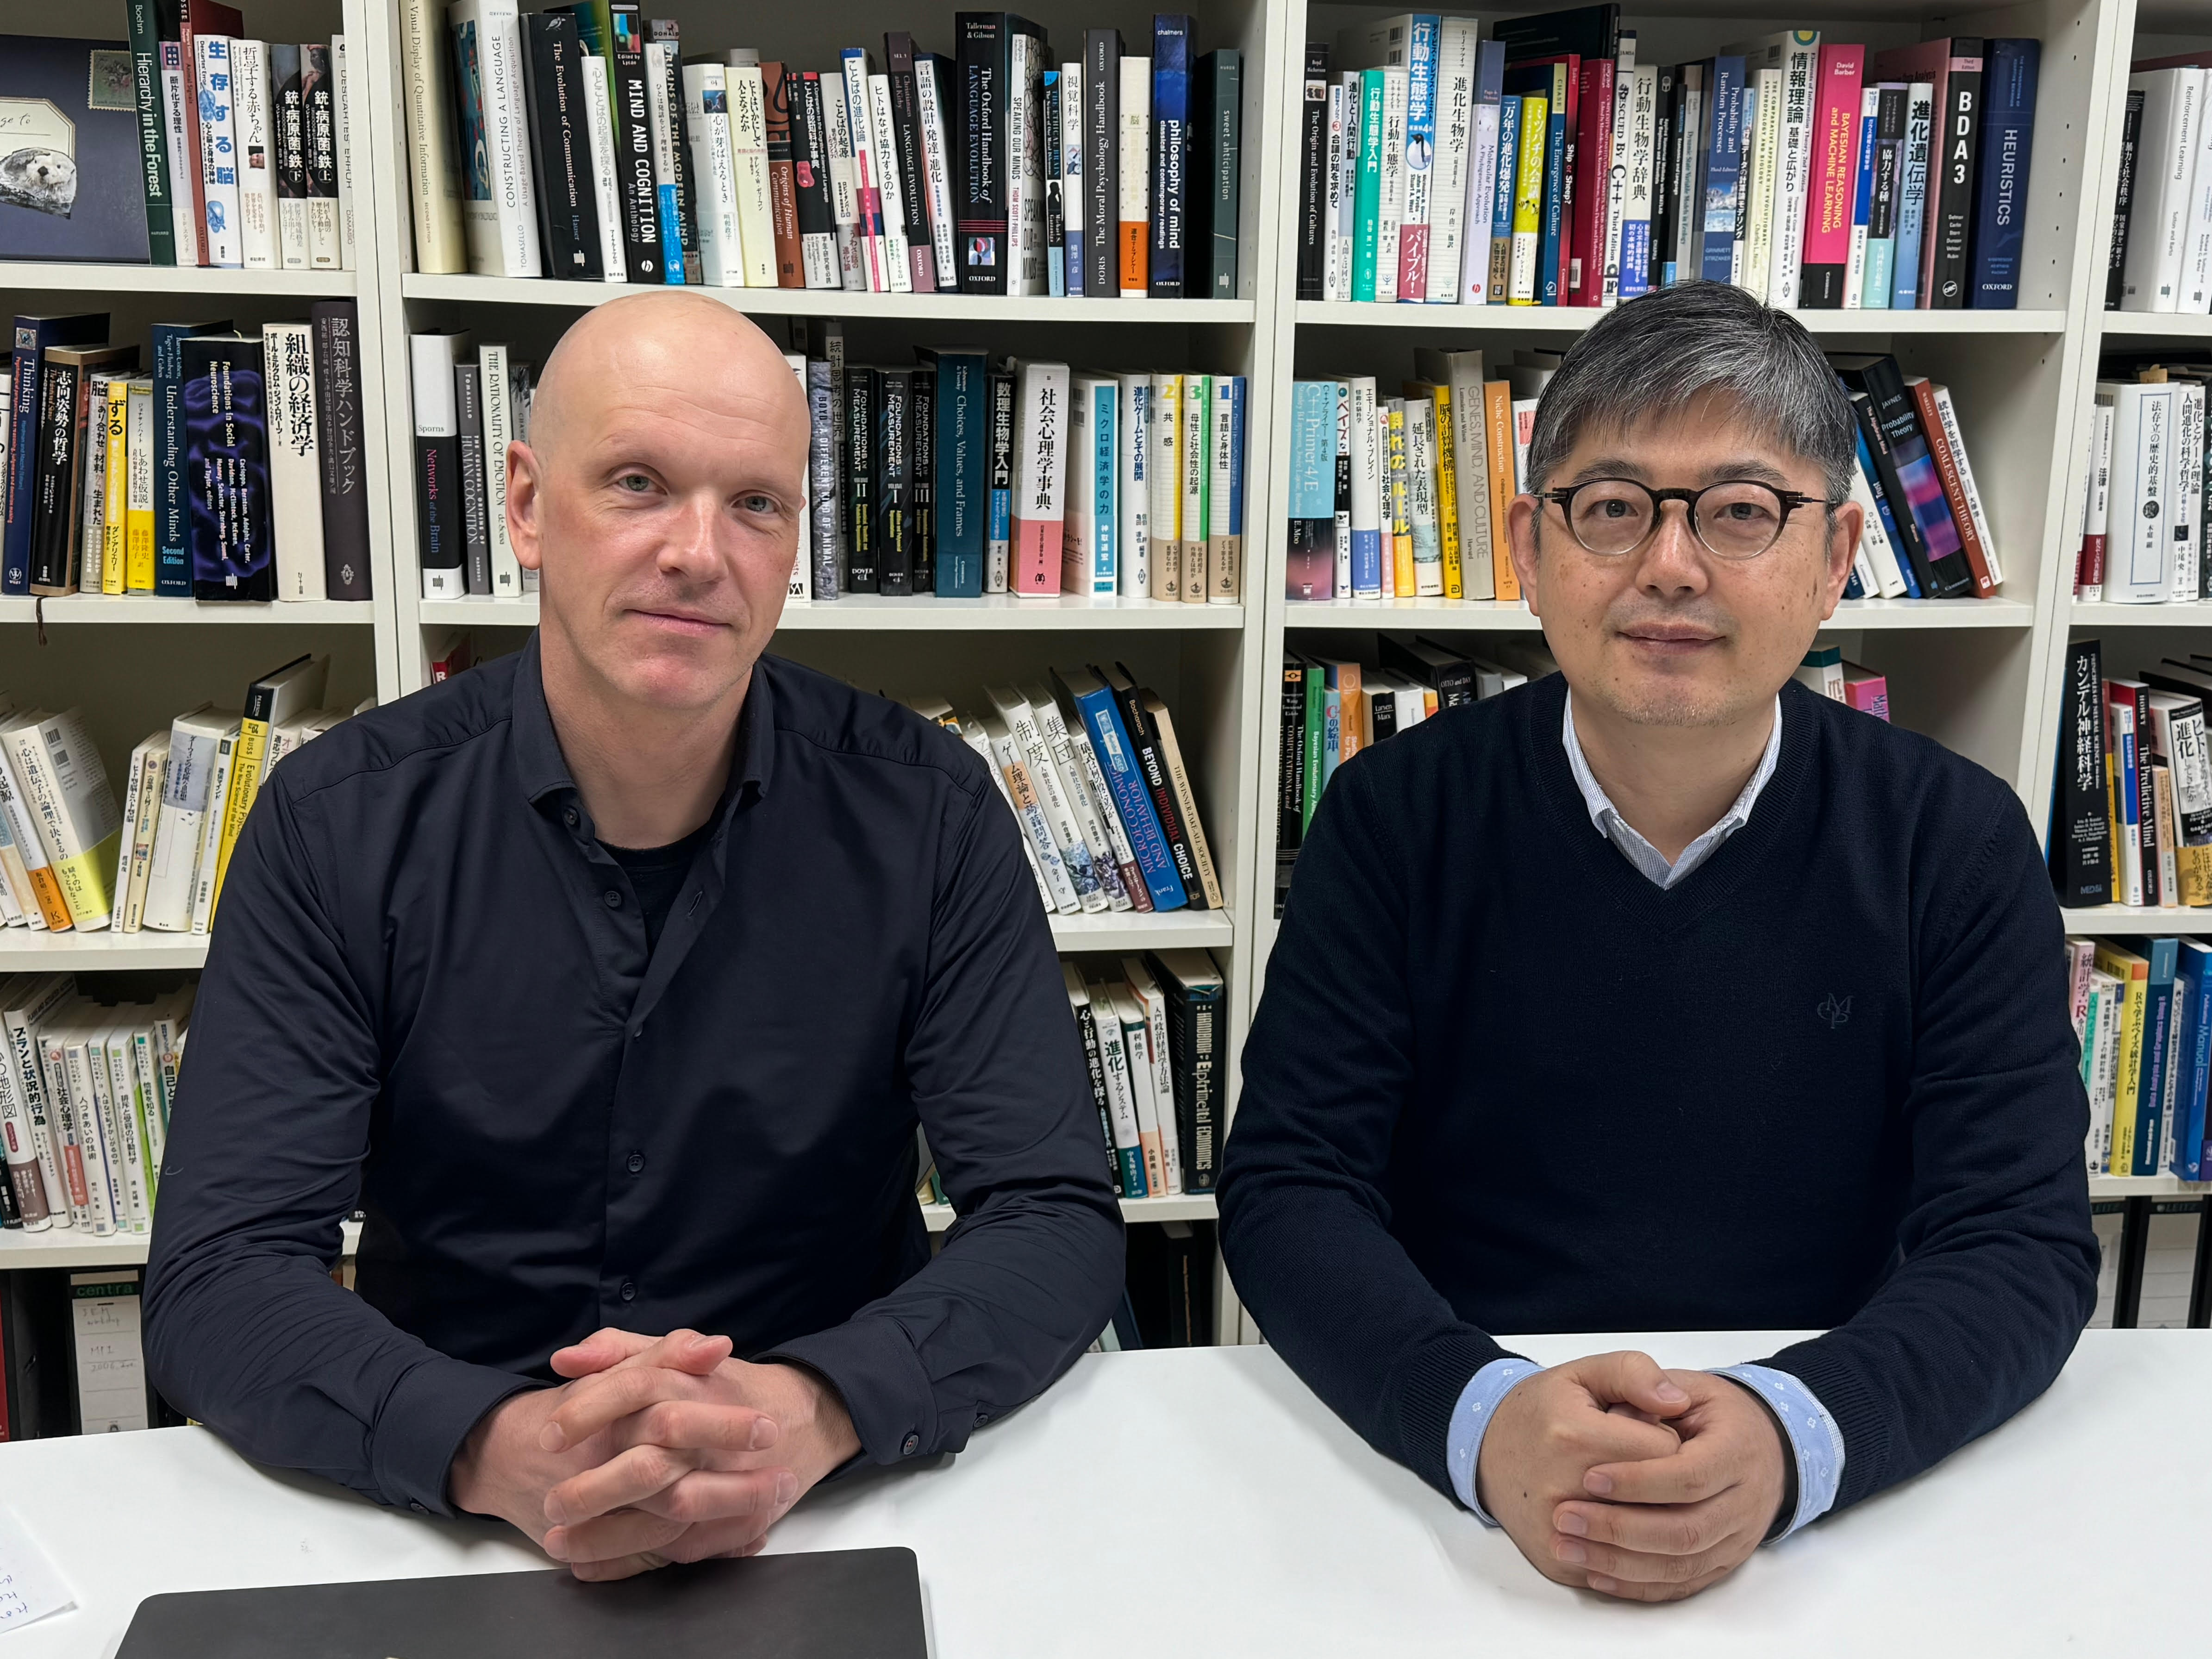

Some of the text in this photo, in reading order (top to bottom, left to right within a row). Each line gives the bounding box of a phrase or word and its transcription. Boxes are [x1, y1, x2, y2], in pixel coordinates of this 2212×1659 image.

[411, 6, 419, 32] Visual
[243, 46, 261, 143] 哲学する赤ちゃん
[415, 73, 423, 81] of
[848, 61, 865, 142] ことばの進化論
[1067, 75, 1078, 130] 視覚科学
[1410, 23, 1430, 120] 行動生態学
[1787, 52, 1806, 123] 情報理論
[137, 53, 162, 197] Hierarchy in the Forest
[208, 41, 234, 185] 生存する脳
[413, 85, 425, 140] Quantitative
[492, 35, 515, 207] CONSTRUCTING A LANGUAGE
[553, 42, 576, 207] The Evolution of Communication
[739, 80, 750, 131] 人となったか
[749, 80, 761, 146] ヒトはいかにして
[835, 99, 849, 157] ことばの起源
[980, 68, 992, 203] The Oxford Handbook of
[1347, 81, 1357, 159] 進化と人間行動
[1368, 88, 1381, 172] 行動生態学入門
[1450, 77, 1467, 152] 進化生物学
[2175, 86, 2193, 180] Reinforcement Learning
[419, 144, 428, 195] Information
[628, 80, 656, 243] MIND AND COGNITION
[713, 115, 728, 203] 心が芽ばえるとき
[875, 86, 894, 200] ヒトはなぜ協力するのか
[1386, 116, 1400, 177] 行動生態学
[1566, 164, 1573, 173] or
[1632, 77, 1652, 200] 行動生物学辞典
[1786, 127, 1799, 192] 基礎と広がり
[1825, 128, 1836, 177] MACHINE
[1905, 100, 1929, 205] 進化遺伝学
[781, 167, 789, 197] Origins
[1168, 120, 1180, 249] philosophy of mind
[1833, 113, 1850, 228] BAYESIAN REASONING
[1996, 130, 2018, 226] HEURISTICS
[772, 172, 783, 235] Communication
[783, 200, 790, 208] of
[1822, 179, 1834, 232] LEARNING
[518, 225, 527, 268] TOMASELLO
[20, 359, 35, 413] Thinking
[210, 362, 219, 413] Neuroscience
[285, 333, 314, 457] 組織の経済学
[331, 319, 355, 495] 認知科学ハンドブック
[956, 395, 966, 439] Choices,
[1162, 385, 1174, 399] 2
[1189, 386, 1201, 399] 3
[1218, 385, 1232, 400] 1
[1307, 384, 1320, 415] C++
[1881, 395, 1901, 409] JAYNES
[226, 423, 235, 447] Social
[994, 382, 1010, 484] 数理生物学入門
[1036, 388, 1056, 510] 社会心理学事典
[1134, 387, 1143, 481] 進化ゲームとその展開
[1219, 414, 1229, 469] 言語と身体性
[1305, 418, 1319, 465] Primer
[1881, 412, 1914, 431] Probability
[1891, 424, 1913, 438] Theory
[2147, 401, 2161, 497] 法存立の歴史的基盤
[2179, 393, 2192, 492] 人間進化の科学哲学
[2191, 399, 2202, 494] 進化とゲーム理論
[138, 449, 148, 505] しあわせ仮説
[163, 385, 179, 541] Understanding Other Minds
[426, 449, 438, 499] Networks
[1099, 404, 1108, 514] ミクロ経済学の力
[1190, 414, 1199, 495] 母性と社会性の起源
[1412, 423, 1428, 515] 延長された表現型
[430, 501, 437, 510] of
[462, 435, 478, 544] HUMAN COGNITION
[956, 479, 964, 495] and
[1936, 438, 1975, 541] COALESCENT THEORY
[162, 546, 184, 555] Second
[163, 556, 183, 565] Edition
[430, 525, 441, 553] Brain
[1129, 700, 1145, 736] Bacharach
[1375, 704, 1392, 712] Larsen
[2077, 656, 2092, 791] カンデル神経科学
[1015, 719, 1049, 768] 制度
[1047, 716, 1076, 765] 集団
[1143, 747, 1193, 880] BEYOND INDIVIDUAL CHOICE
[2139, 745, 2155, 847] The Predictive Mind
[80, 1097, 96, 1160] 人つきあいの技術
[77, 1283, 133, 1296] centra
